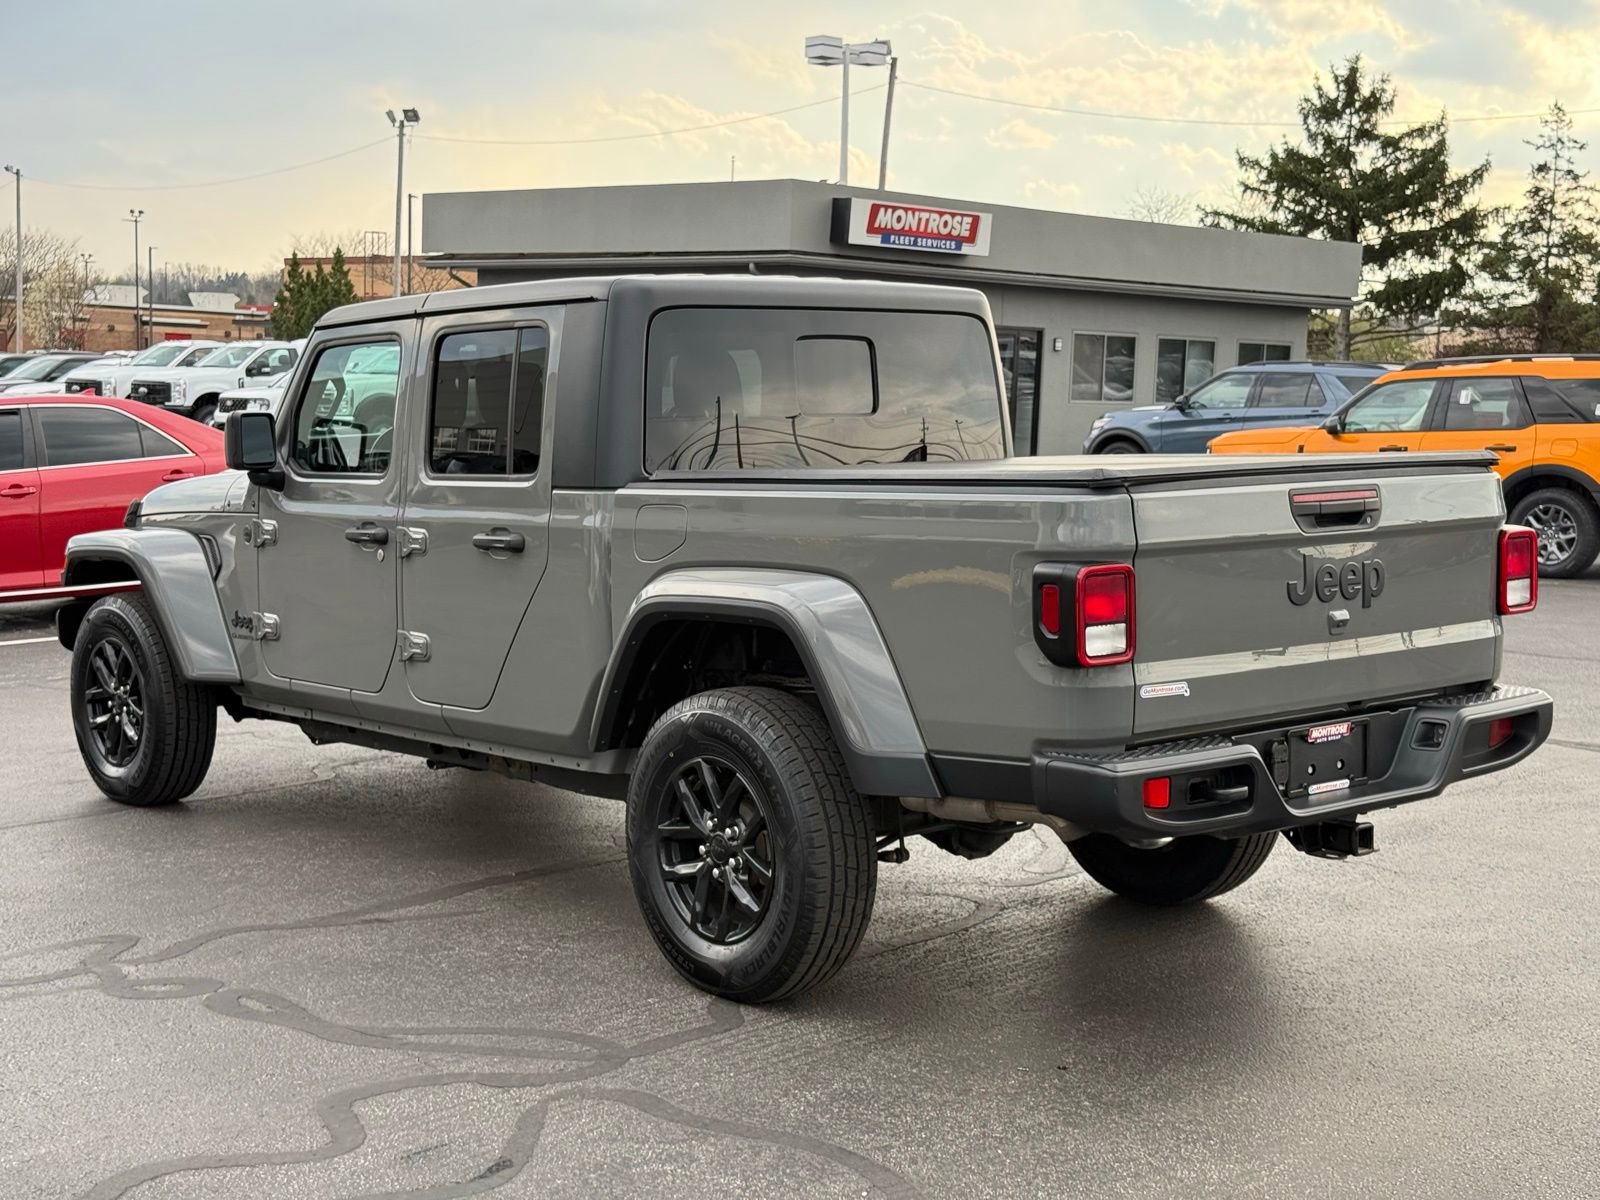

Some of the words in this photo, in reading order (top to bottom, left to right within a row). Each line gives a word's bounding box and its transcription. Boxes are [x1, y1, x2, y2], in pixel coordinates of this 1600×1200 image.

[873, 207, 973, 237] MONTROSE
[890, 235, 915, 246] FLEET
[917, 237, 956, 250] SERVICES
[1286, 553, 1386, 609] Jeep
[231, 610, 253, 633] Jeep
[1310, 724, 1349, 739] MONTROSE
[1308, 781, 1349, 794] GoMontrose.com
